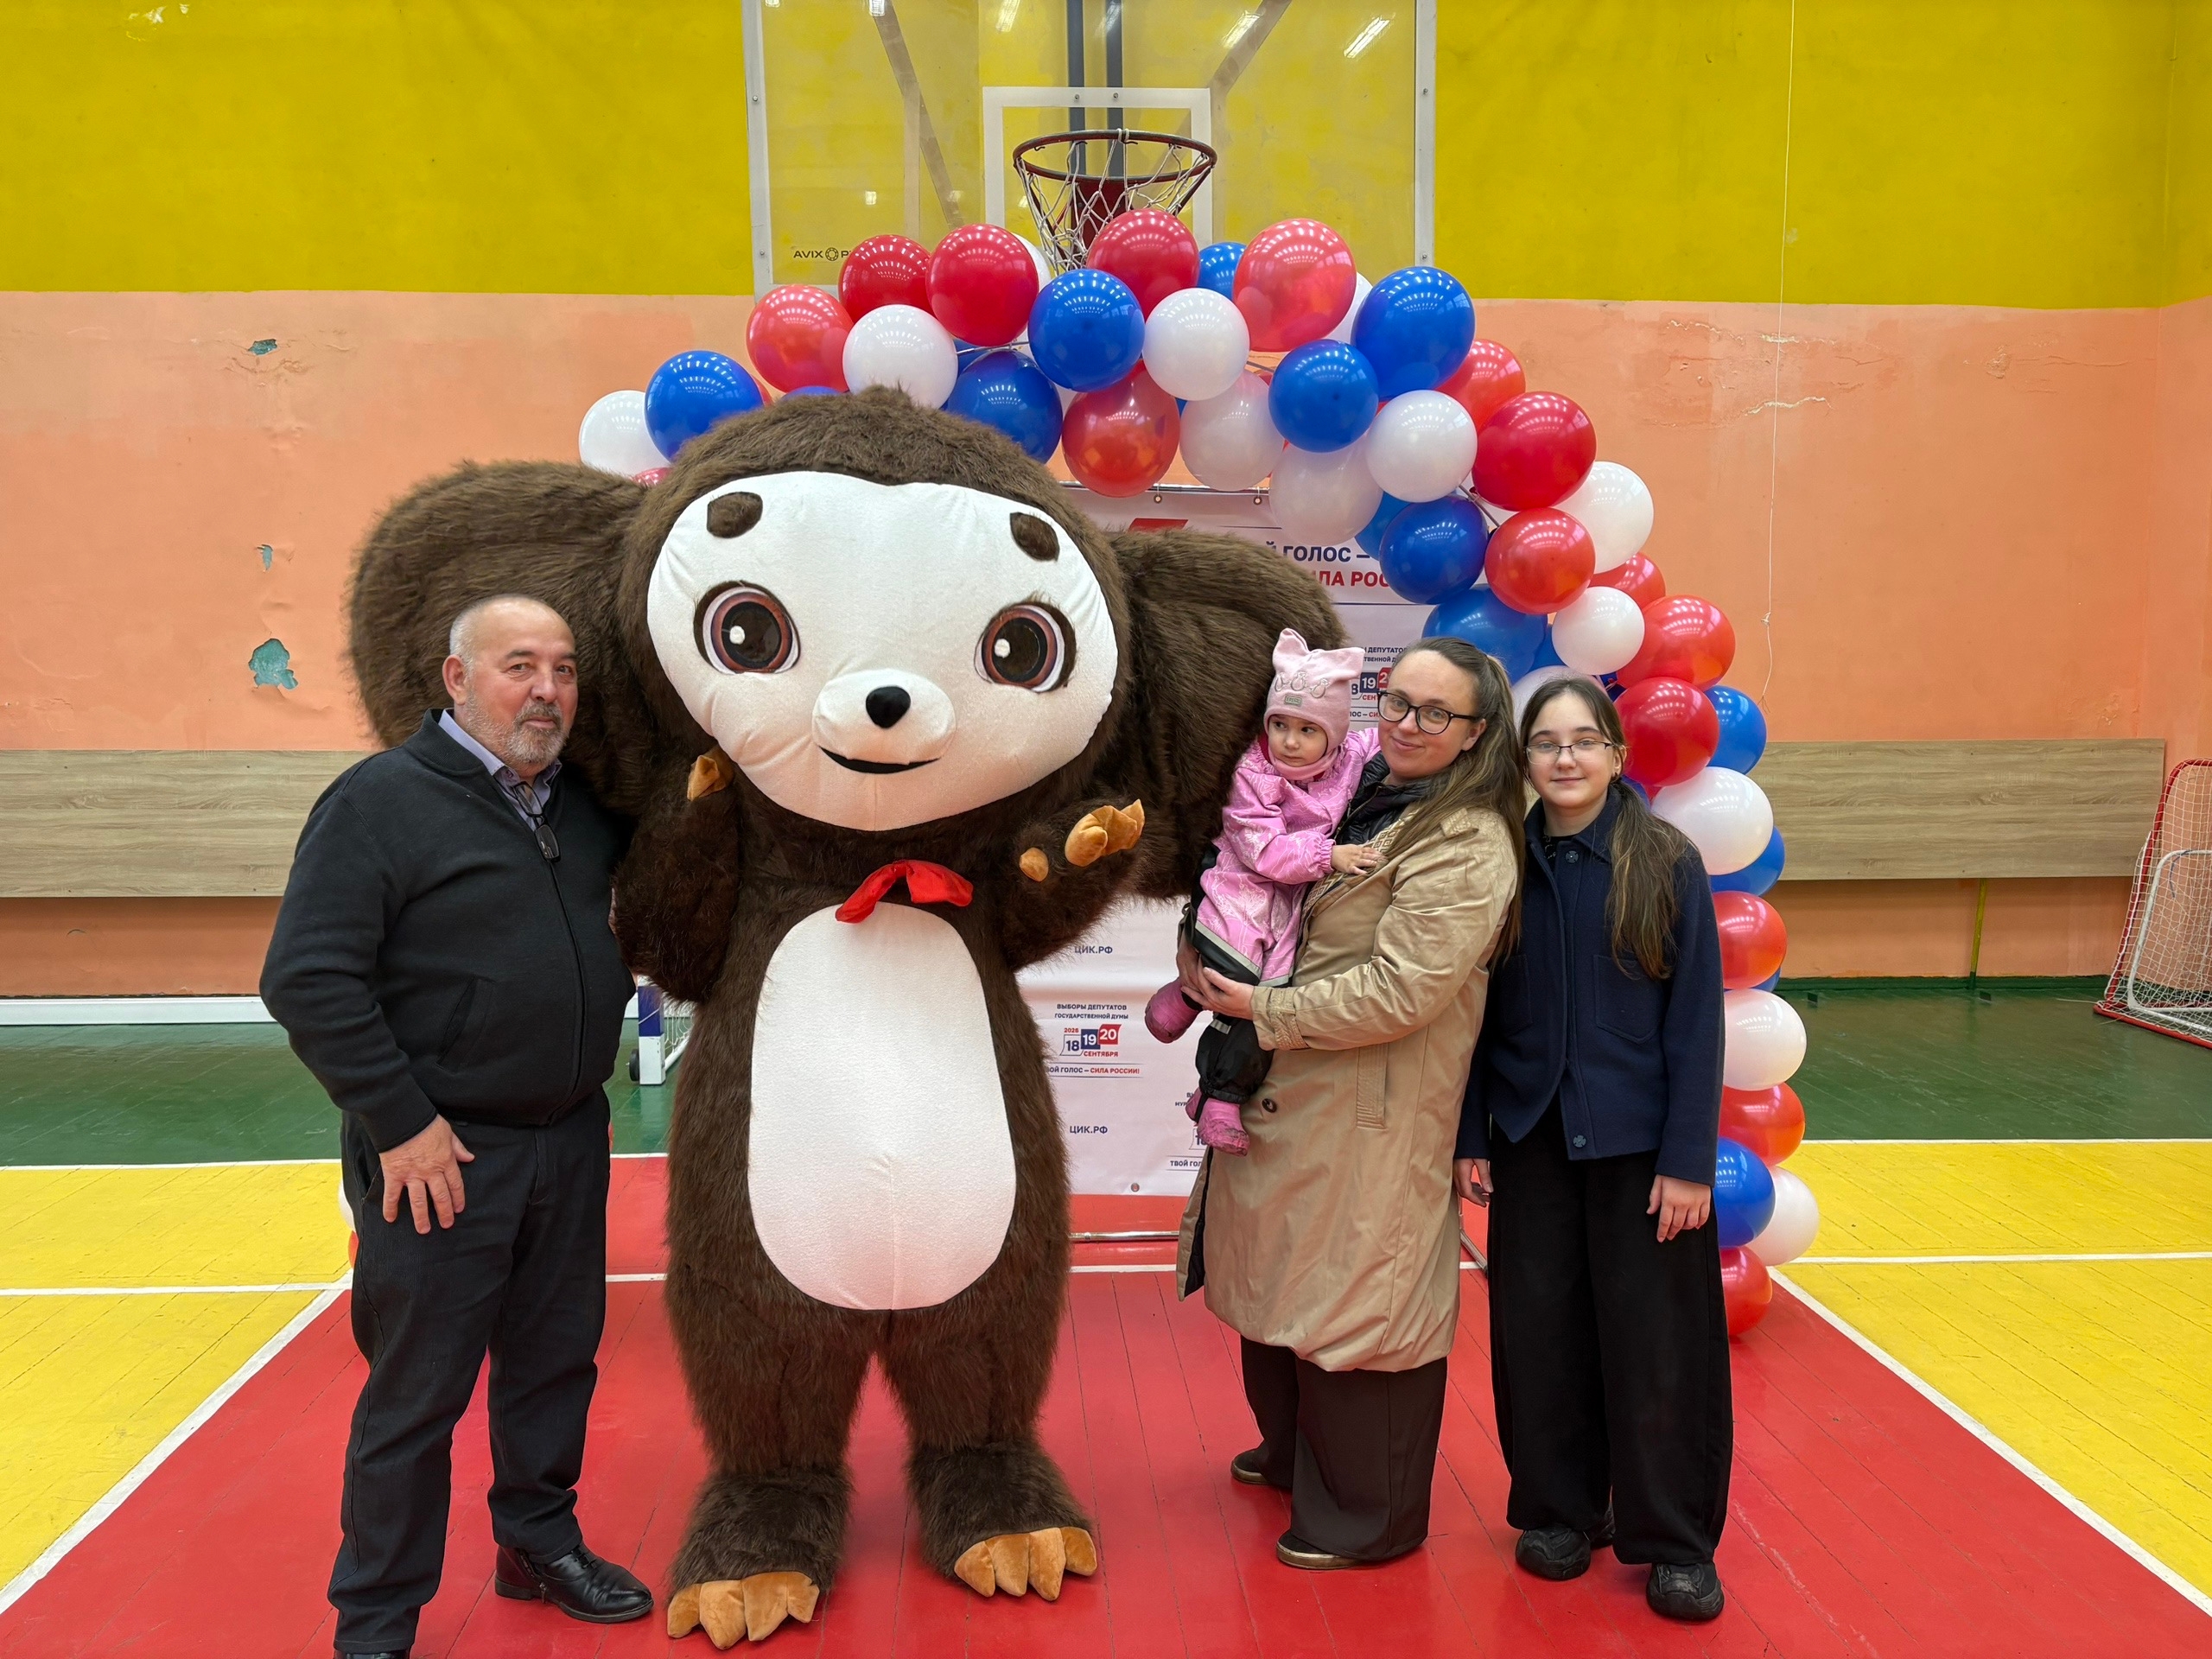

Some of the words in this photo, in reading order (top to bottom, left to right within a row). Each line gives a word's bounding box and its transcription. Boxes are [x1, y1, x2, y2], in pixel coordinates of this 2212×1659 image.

[1283, 545, 1351, 563] ГОЛОС
[1313, 570, 1344, 586] ЛА
[1362, 677, 1376, 689] 19
[1379, 671, 1388, 683] 2
[1351, 683, 1358, 695] 8
[1074, 945, 1113, 954] ЦИК.РФ
[1083, 1033, 1096, 1046] 19
[1099, 1028, 1116, 1040] 20
[1065, 1040, 1079, 1052] 18
[1069, 1125, 1108, 1134] ЦИК.РФ
